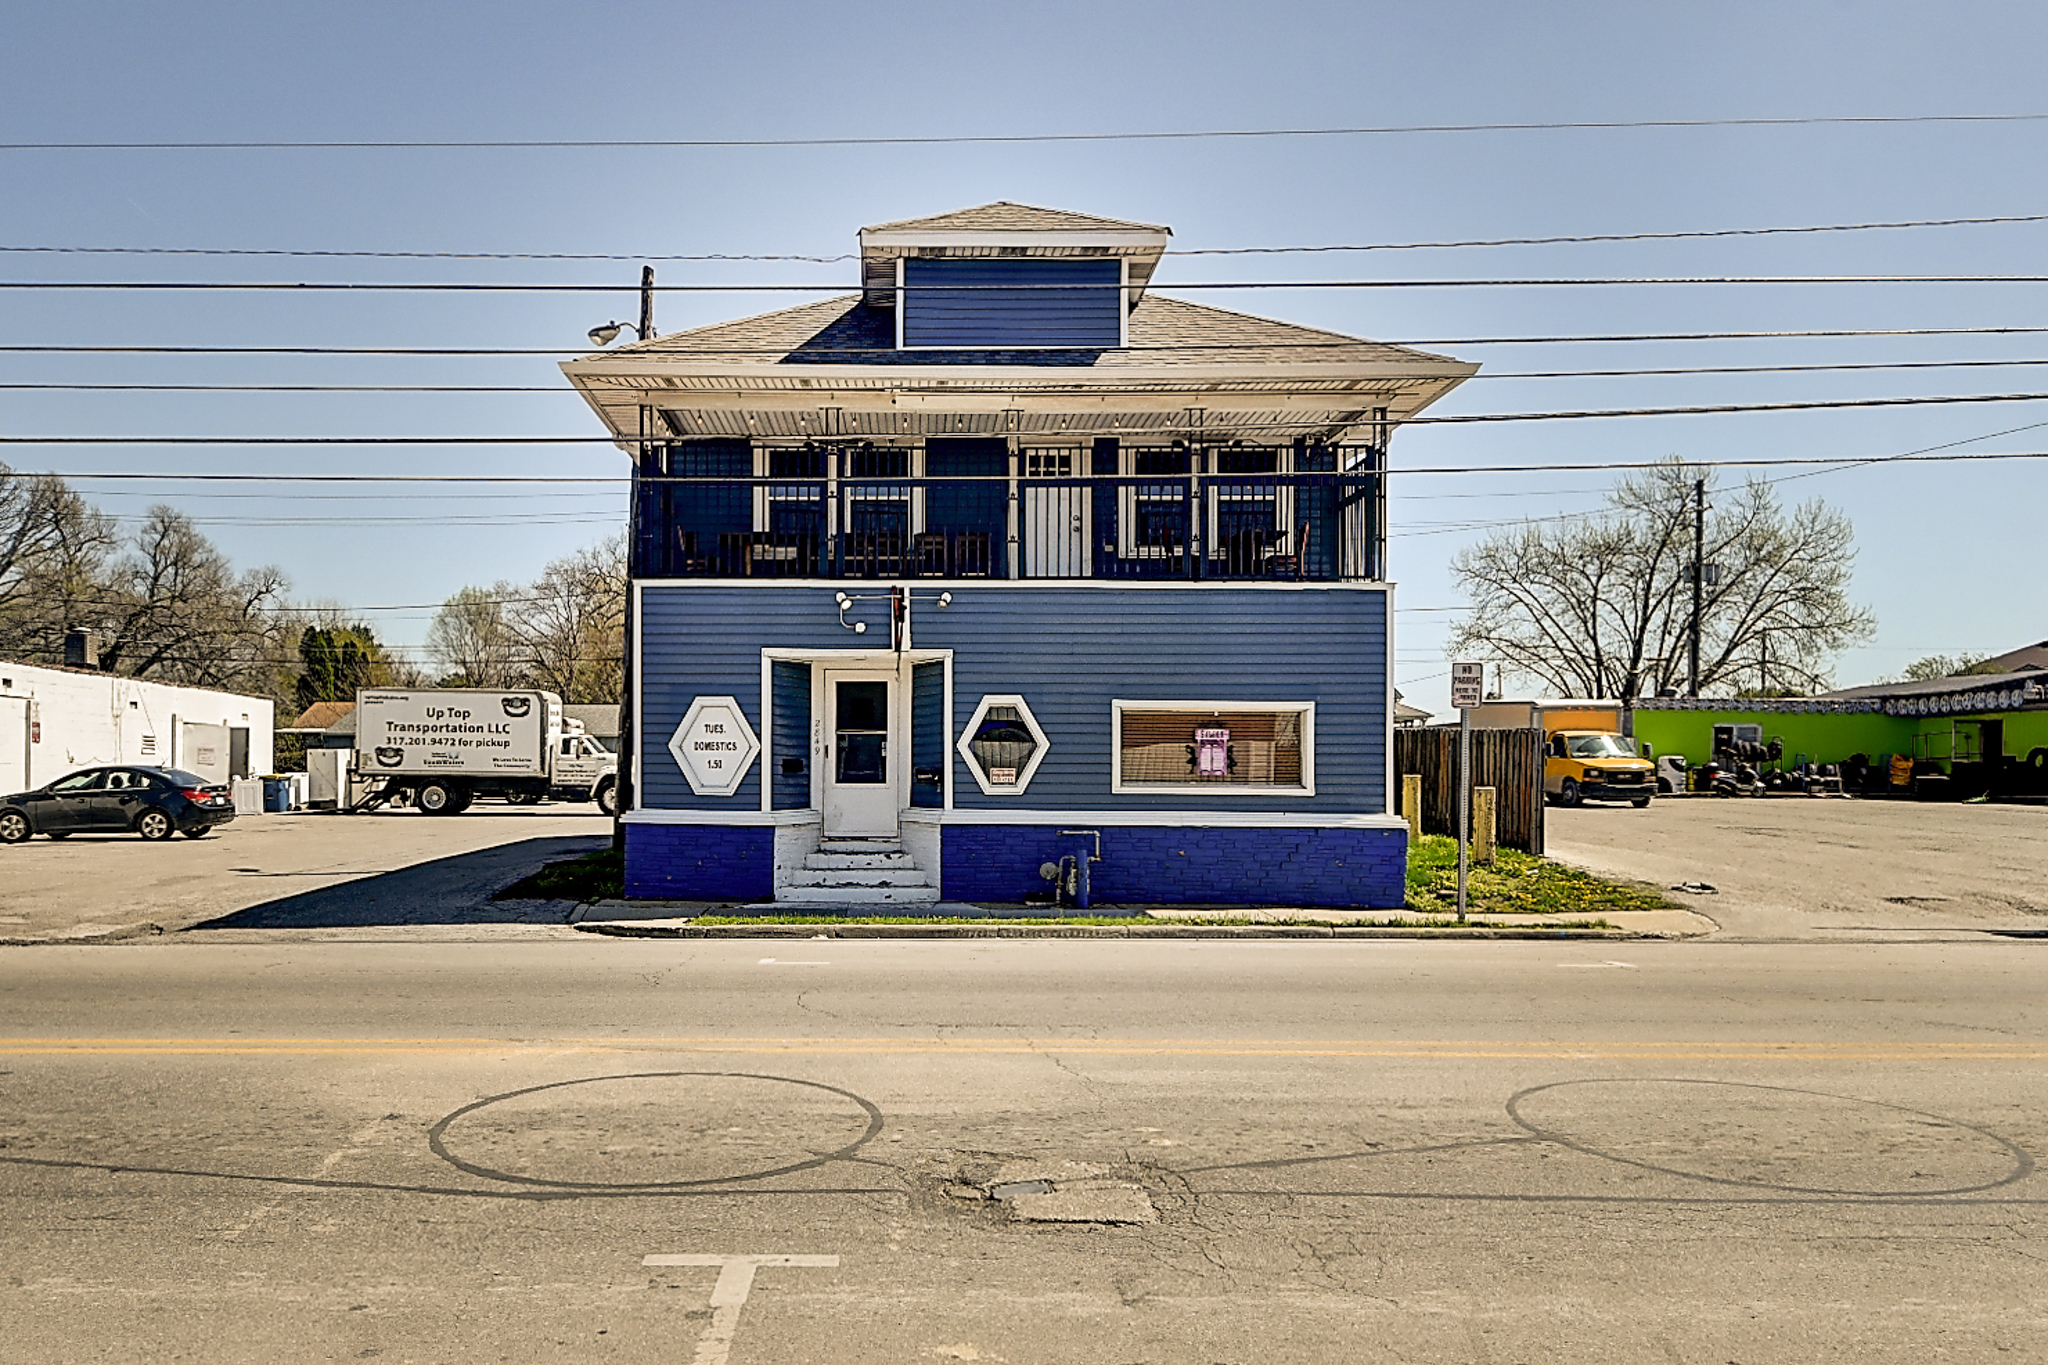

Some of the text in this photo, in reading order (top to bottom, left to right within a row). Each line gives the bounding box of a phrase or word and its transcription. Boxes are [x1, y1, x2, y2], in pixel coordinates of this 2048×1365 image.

[1461, 665, 1473, 675] NO
[1453, 676, 1481, 686] PARKING
[426, 707, 471, 720] Up Top
[386, 721, 511, 735] Transportation LLC
[704, 724, 727, 733] TUES.
[386, 736, 511, 749] 317.201.9472 for pickup
[694, 741, 738, 751] DOMESTICS
